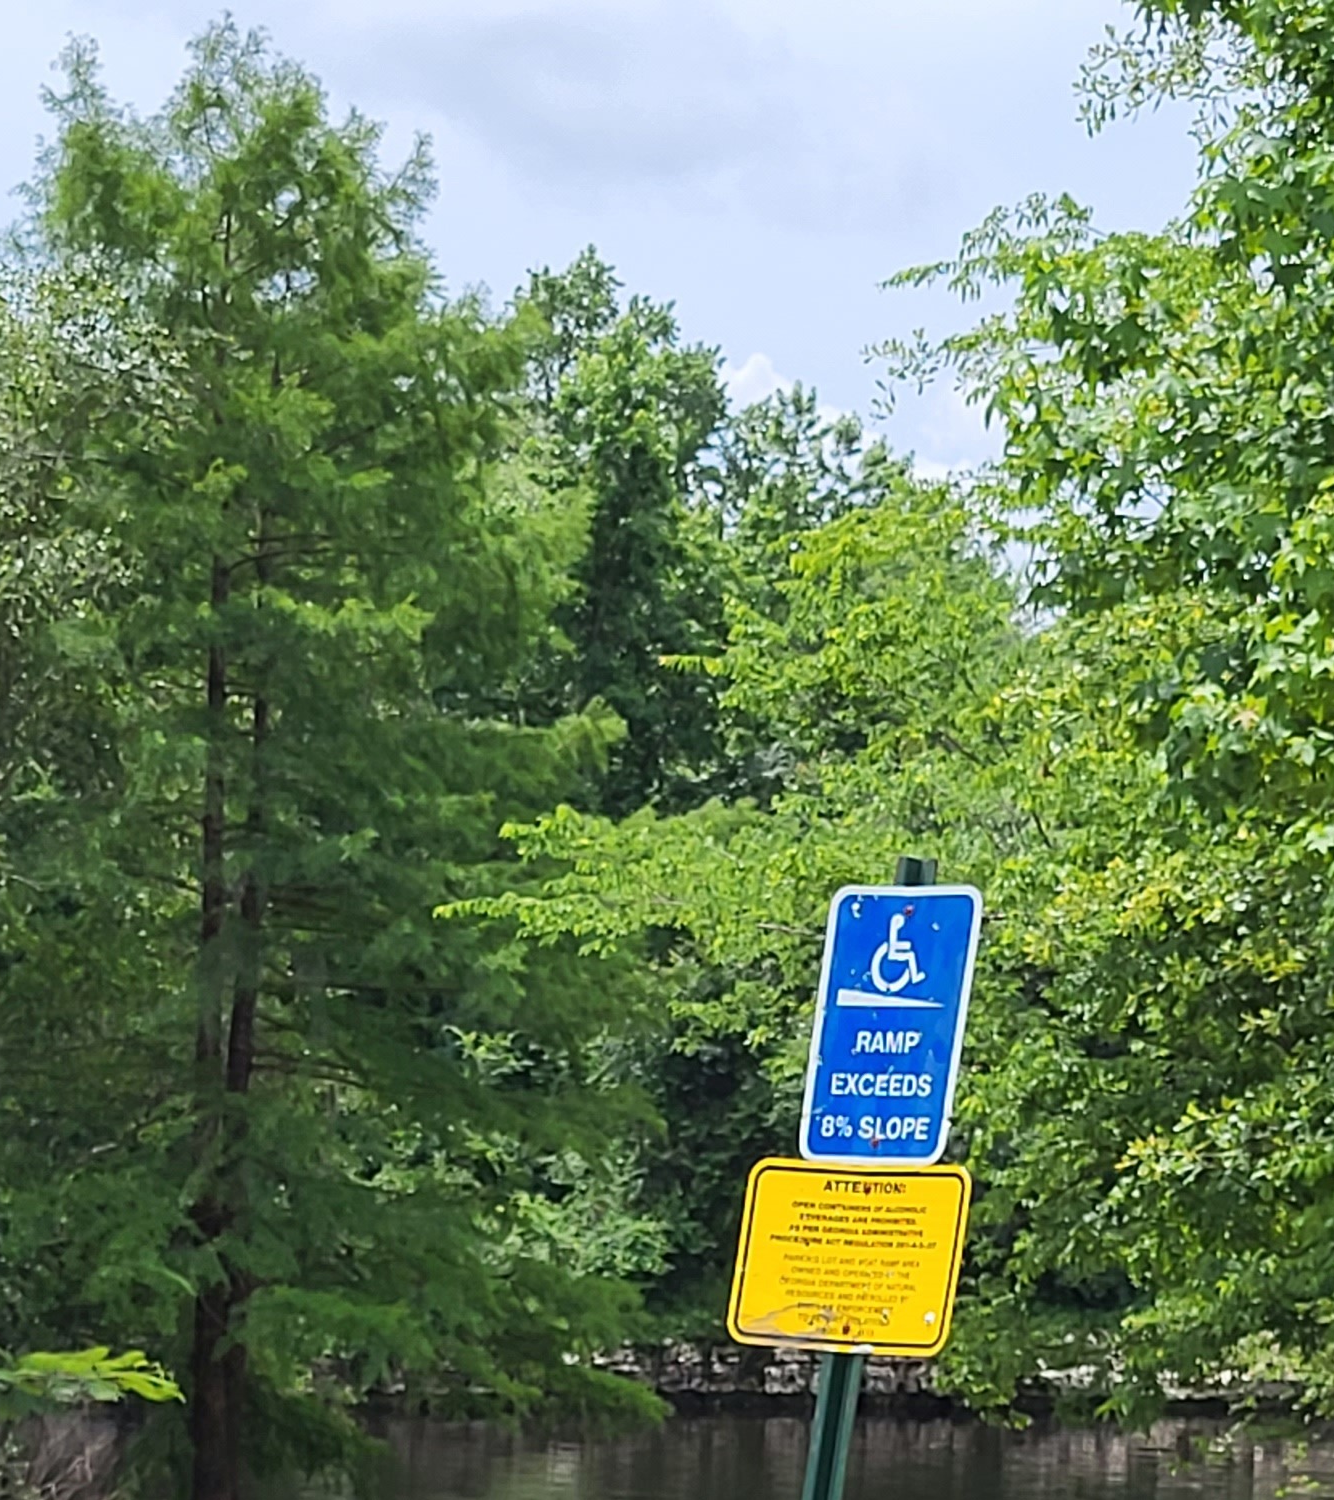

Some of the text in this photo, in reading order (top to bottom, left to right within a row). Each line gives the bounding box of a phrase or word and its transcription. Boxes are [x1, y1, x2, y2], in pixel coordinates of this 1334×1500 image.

[856, 1030, 920, 1053] RAMP
[830, 1073, 933, 1097] EXCEEDS
[821, 1115, 931, 1140] 8% SLOPE
